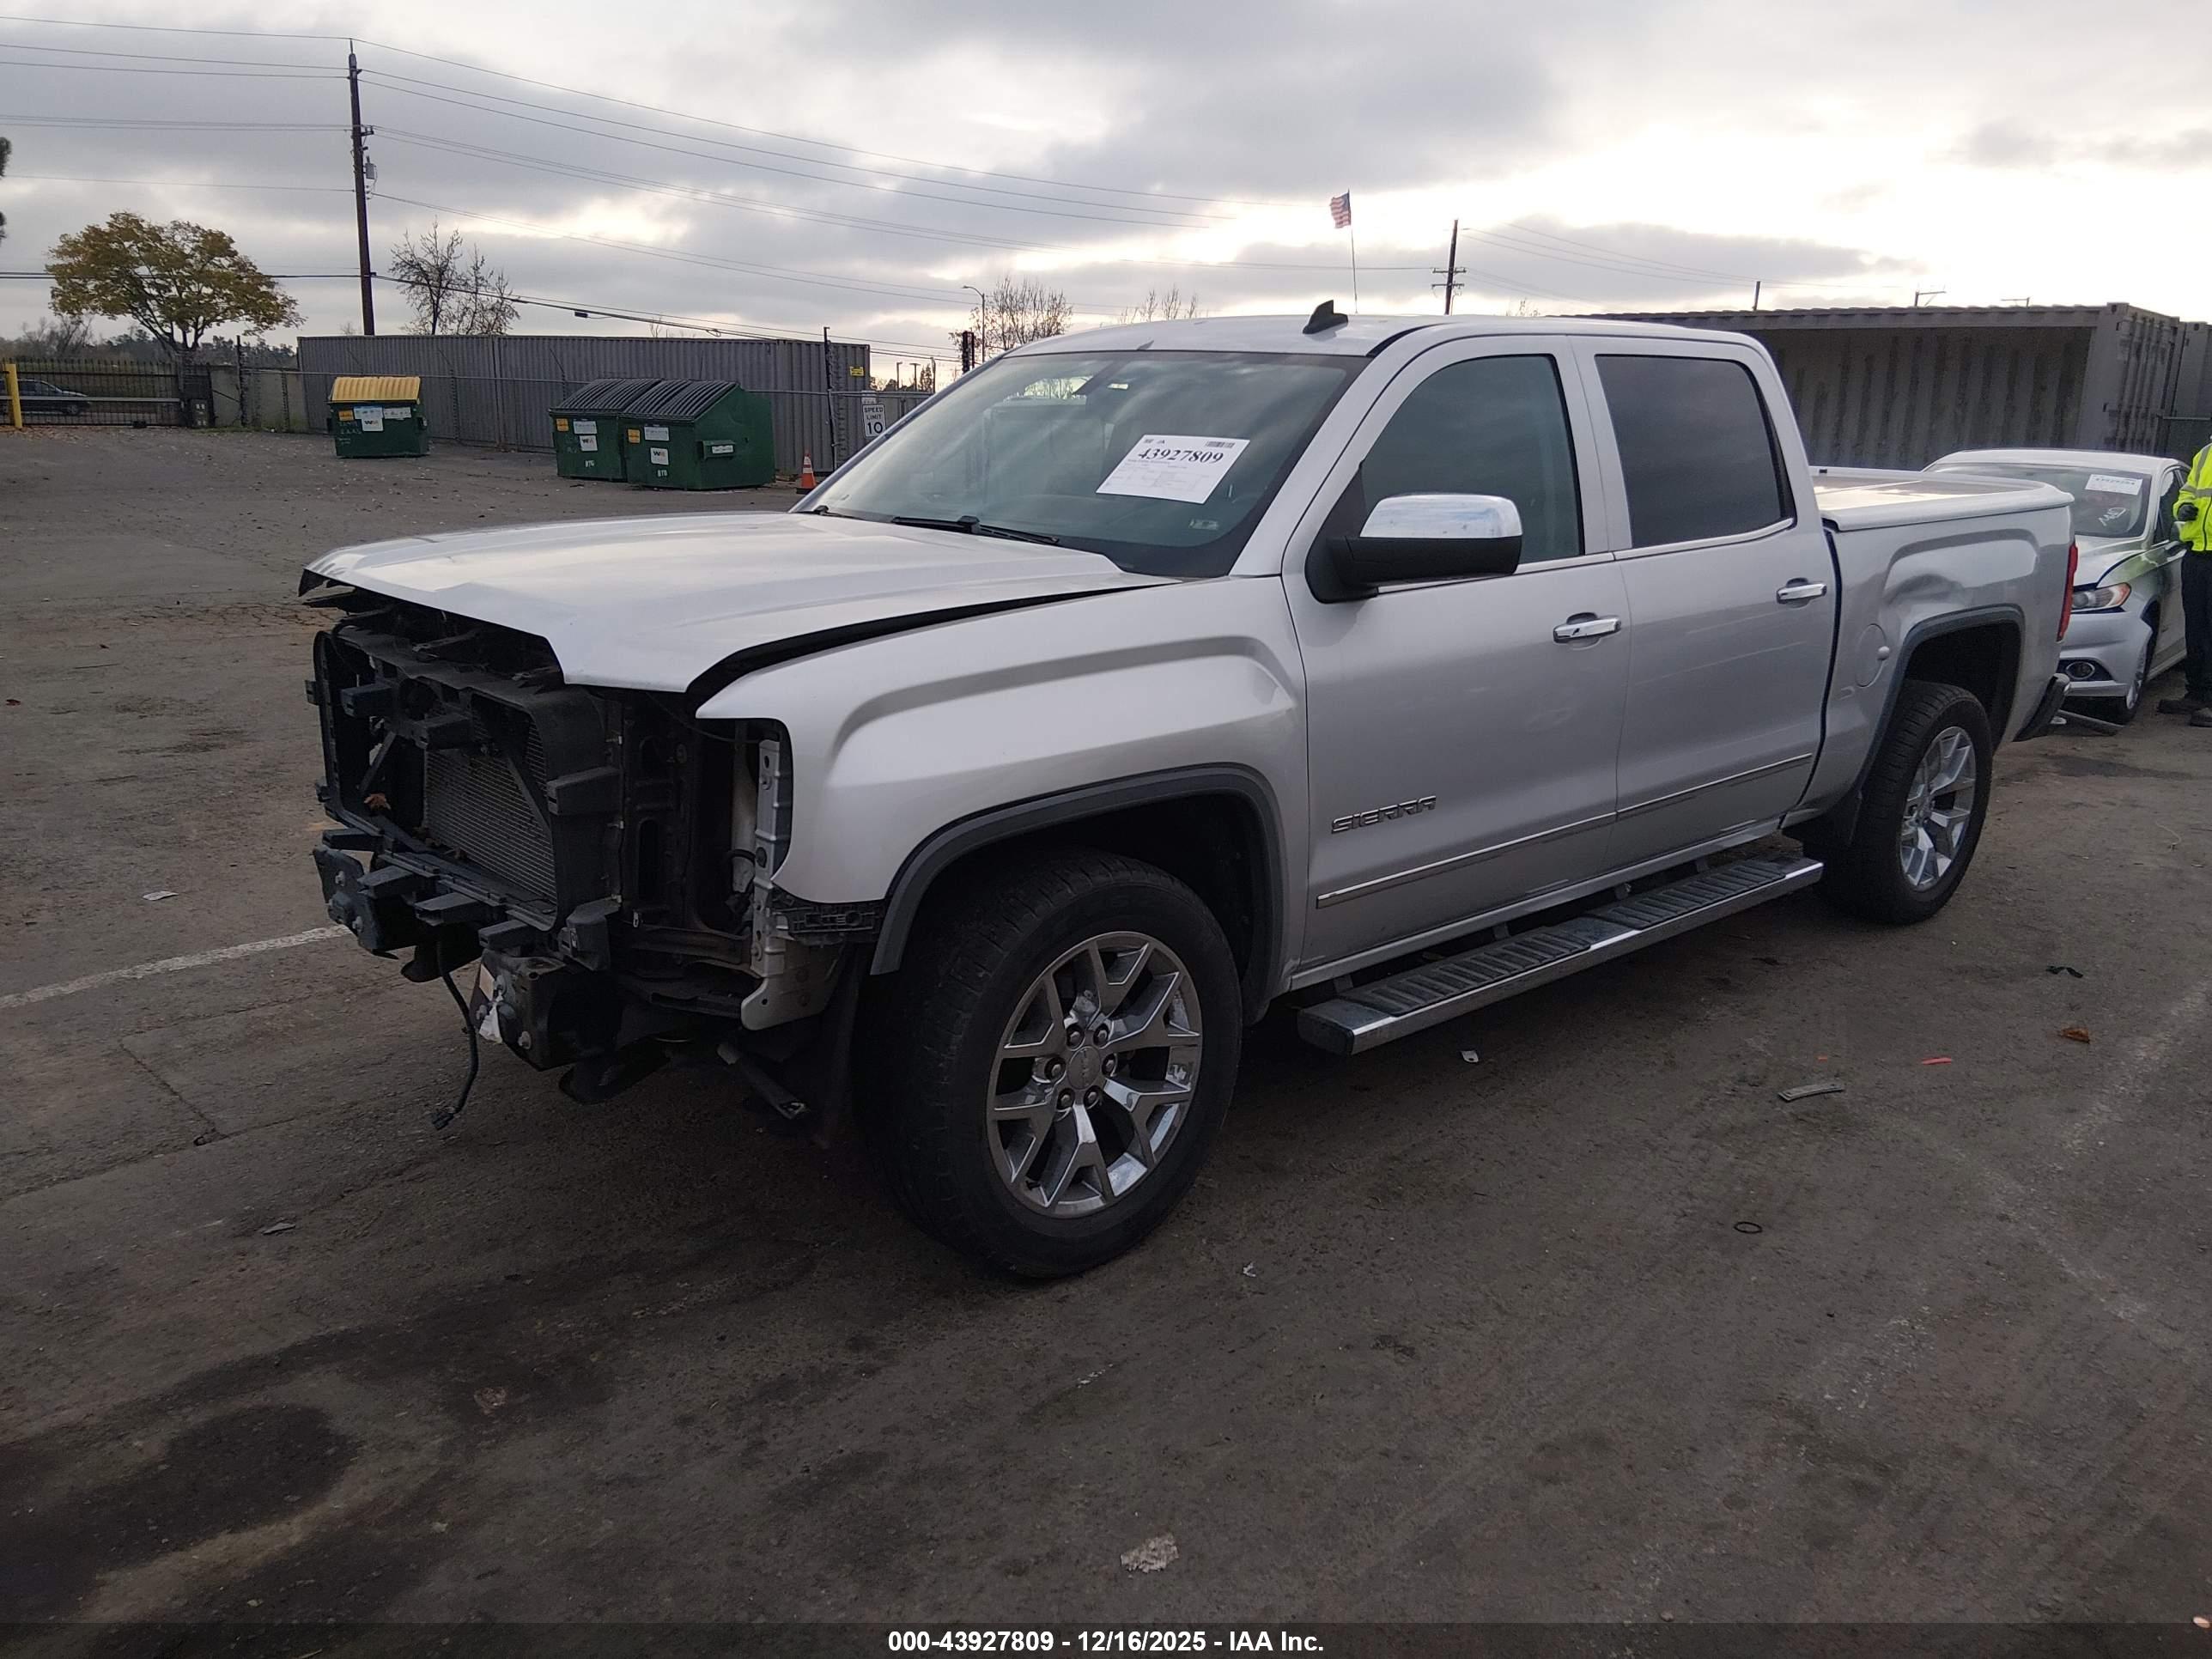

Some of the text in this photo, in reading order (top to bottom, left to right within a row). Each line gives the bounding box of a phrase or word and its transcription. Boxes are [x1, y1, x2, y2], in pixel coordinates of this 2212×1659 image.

[867, 422, 884, 434] 10
[1138, 447, 1224, 464] 43927809
[1331, 795, 1437, 834] SIERRA
